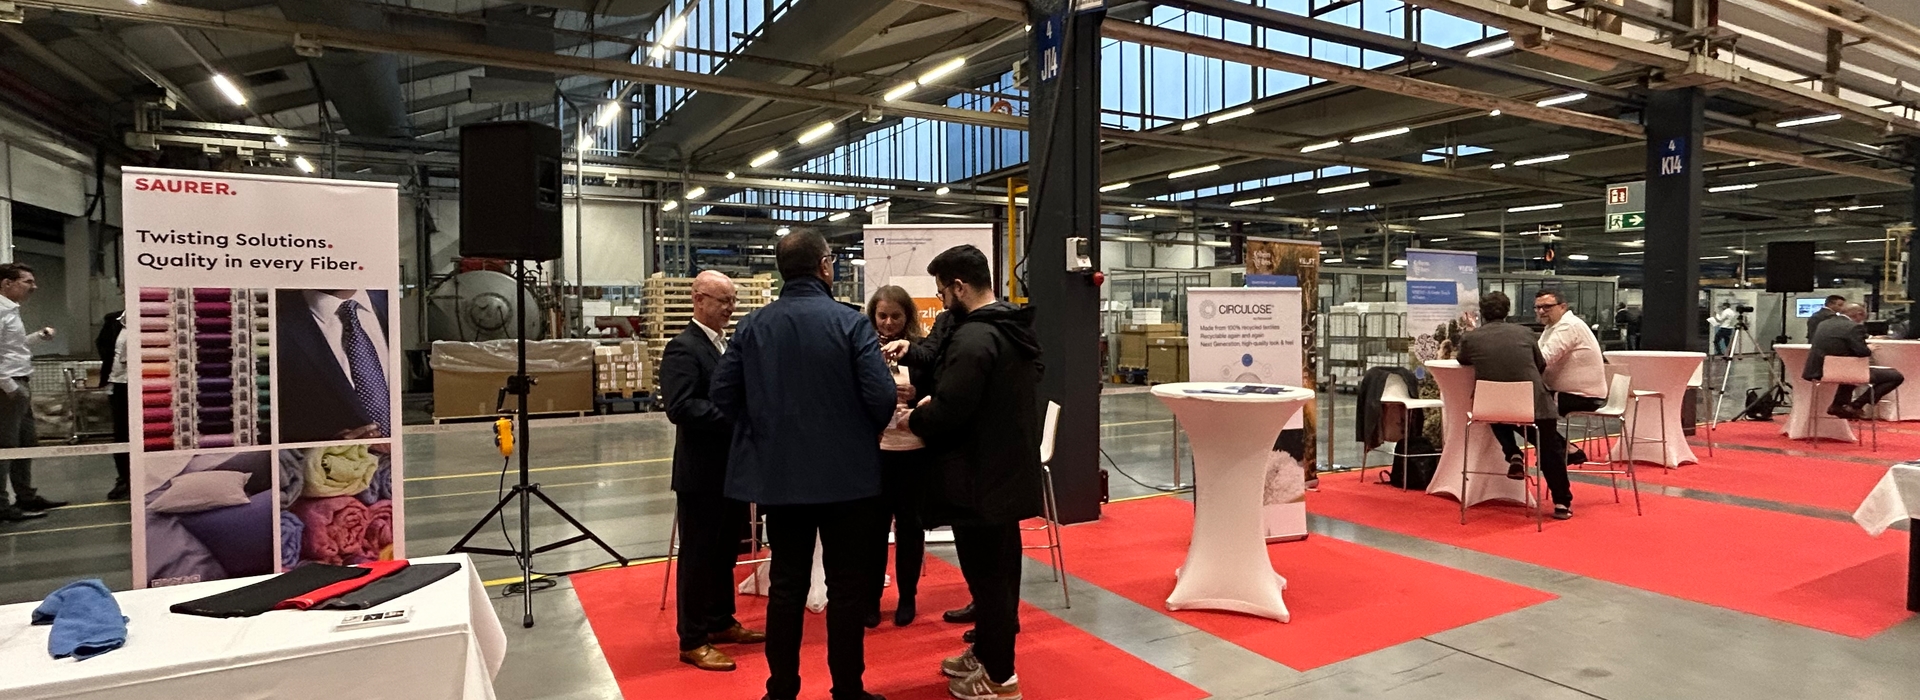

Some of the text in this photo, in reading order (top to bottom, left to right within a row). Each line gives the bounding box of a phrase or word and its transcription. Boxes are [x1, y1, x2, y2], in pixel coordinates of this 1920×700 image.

[1046, 20, 1053, 39] 4
[1041, 46, 1058, 80] J14
[1668, 139, 1676, 151] 4
[1661, 155, 1683, 175] K14
[135, 178, 237, 195] SAURER.
[136, 229, 333, 249] Twisting Solutions.
[137, 253, 364, 272] Quality in every Fiber.
